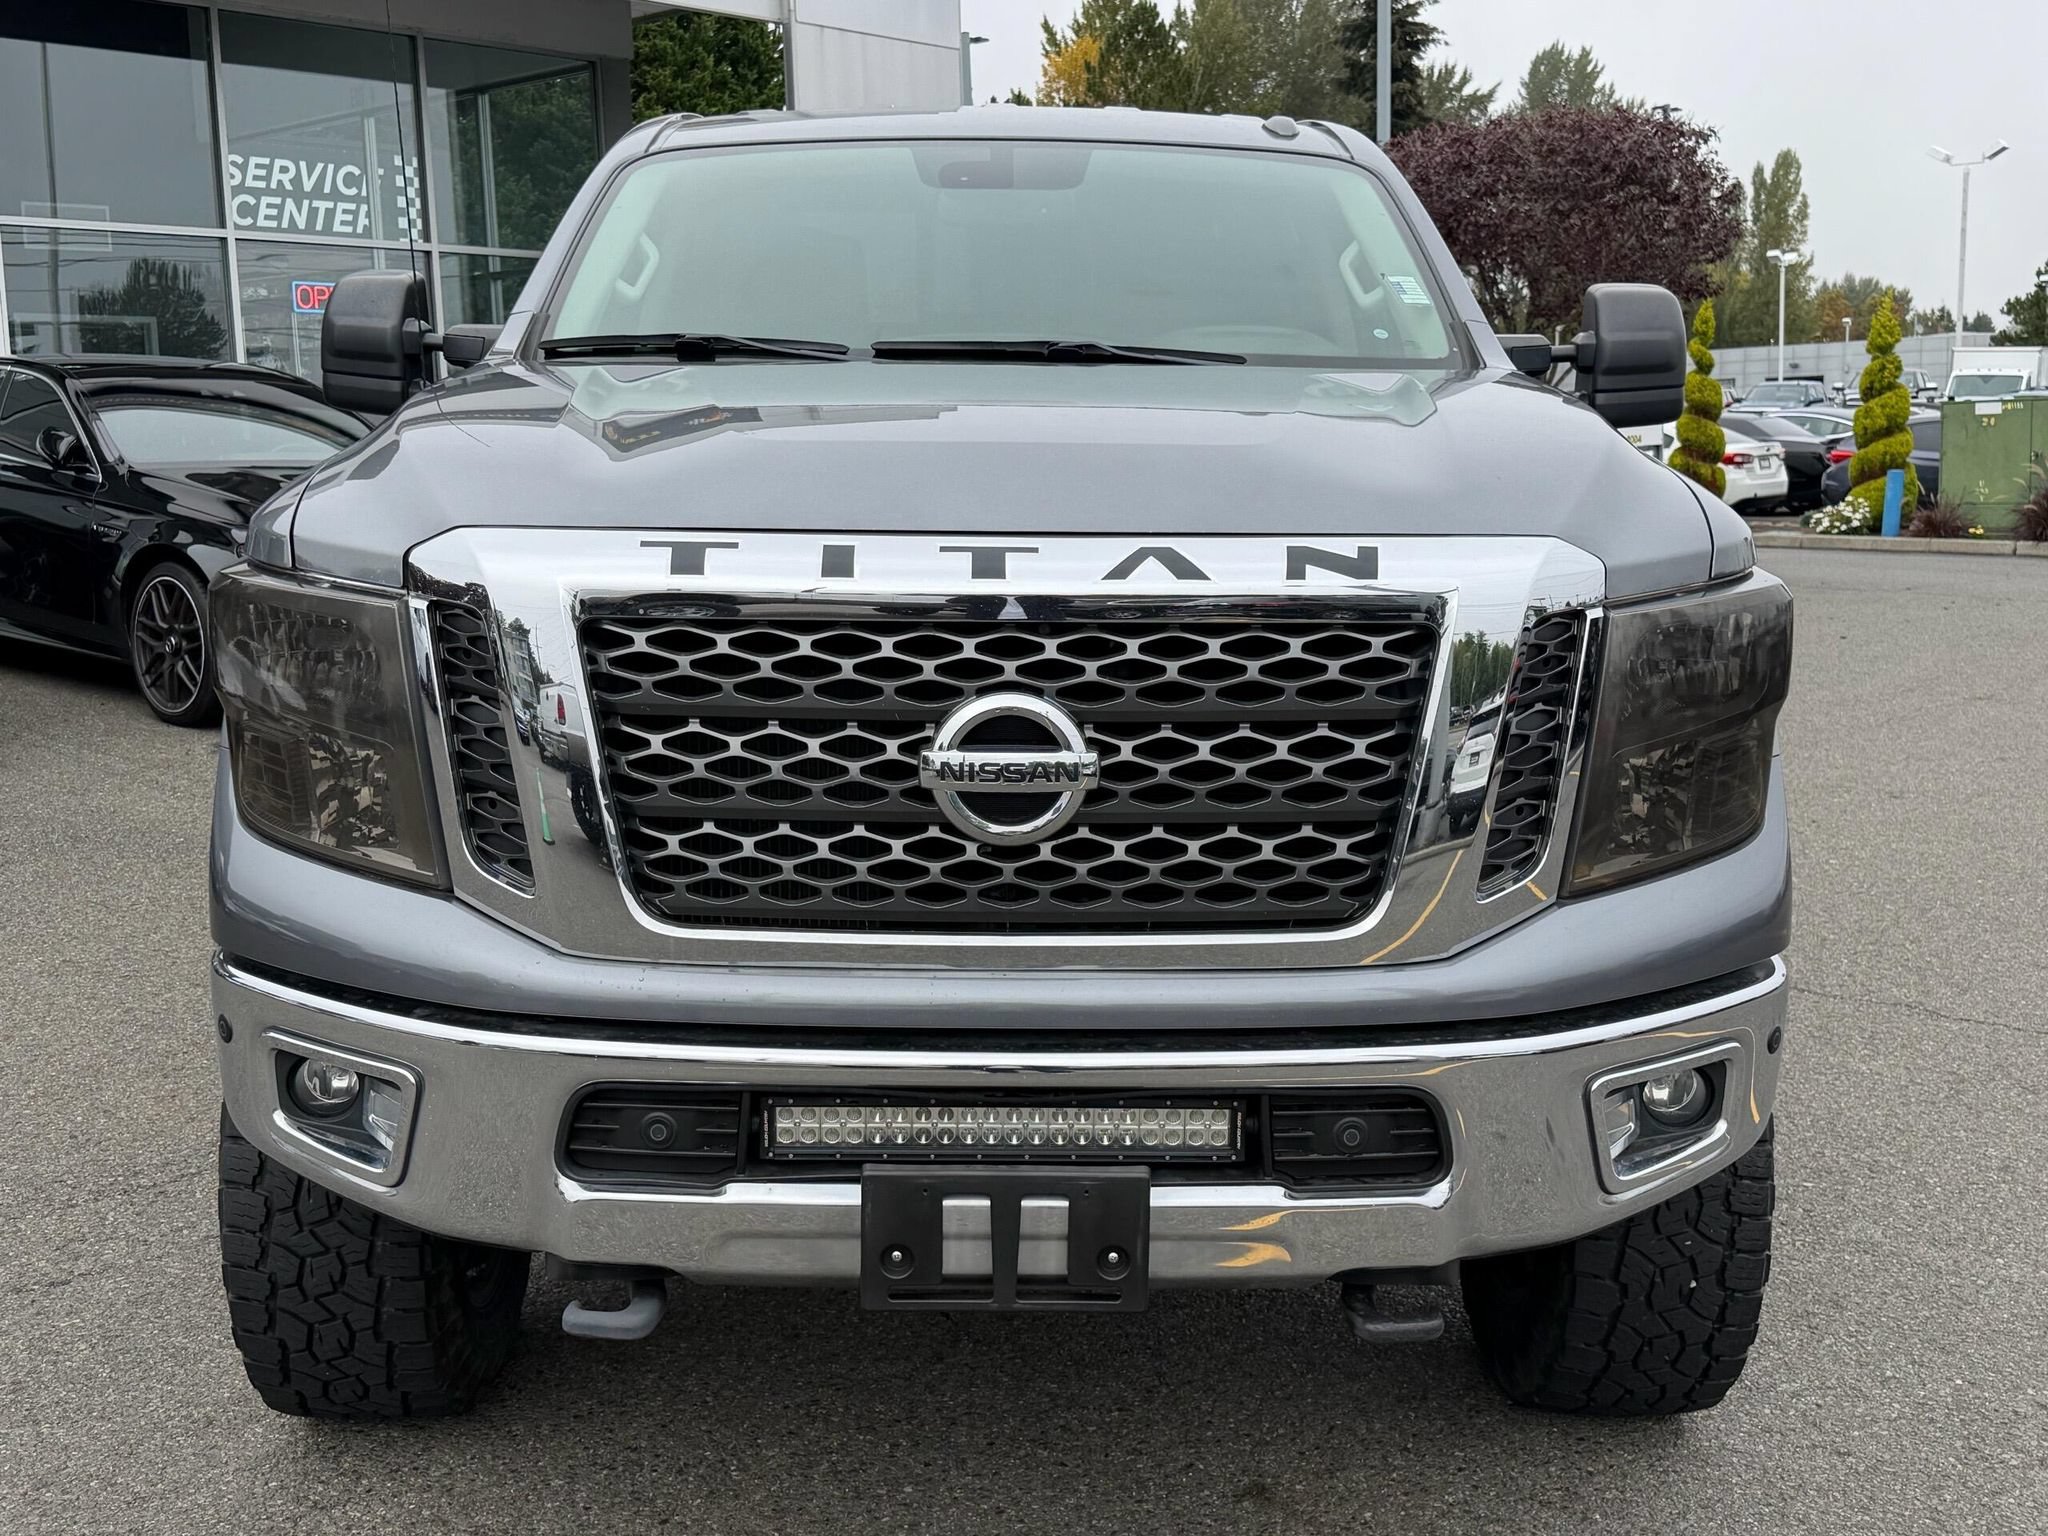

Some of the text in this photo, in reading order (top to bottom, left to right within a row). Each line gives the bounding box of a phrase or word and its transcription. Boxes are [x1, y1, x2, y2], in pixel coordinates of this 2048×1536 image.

[297, 285, 334, 309] OP
[639, 541, 1379, 580] TITAN
[939, 761, 1079, 784] NISSAN
